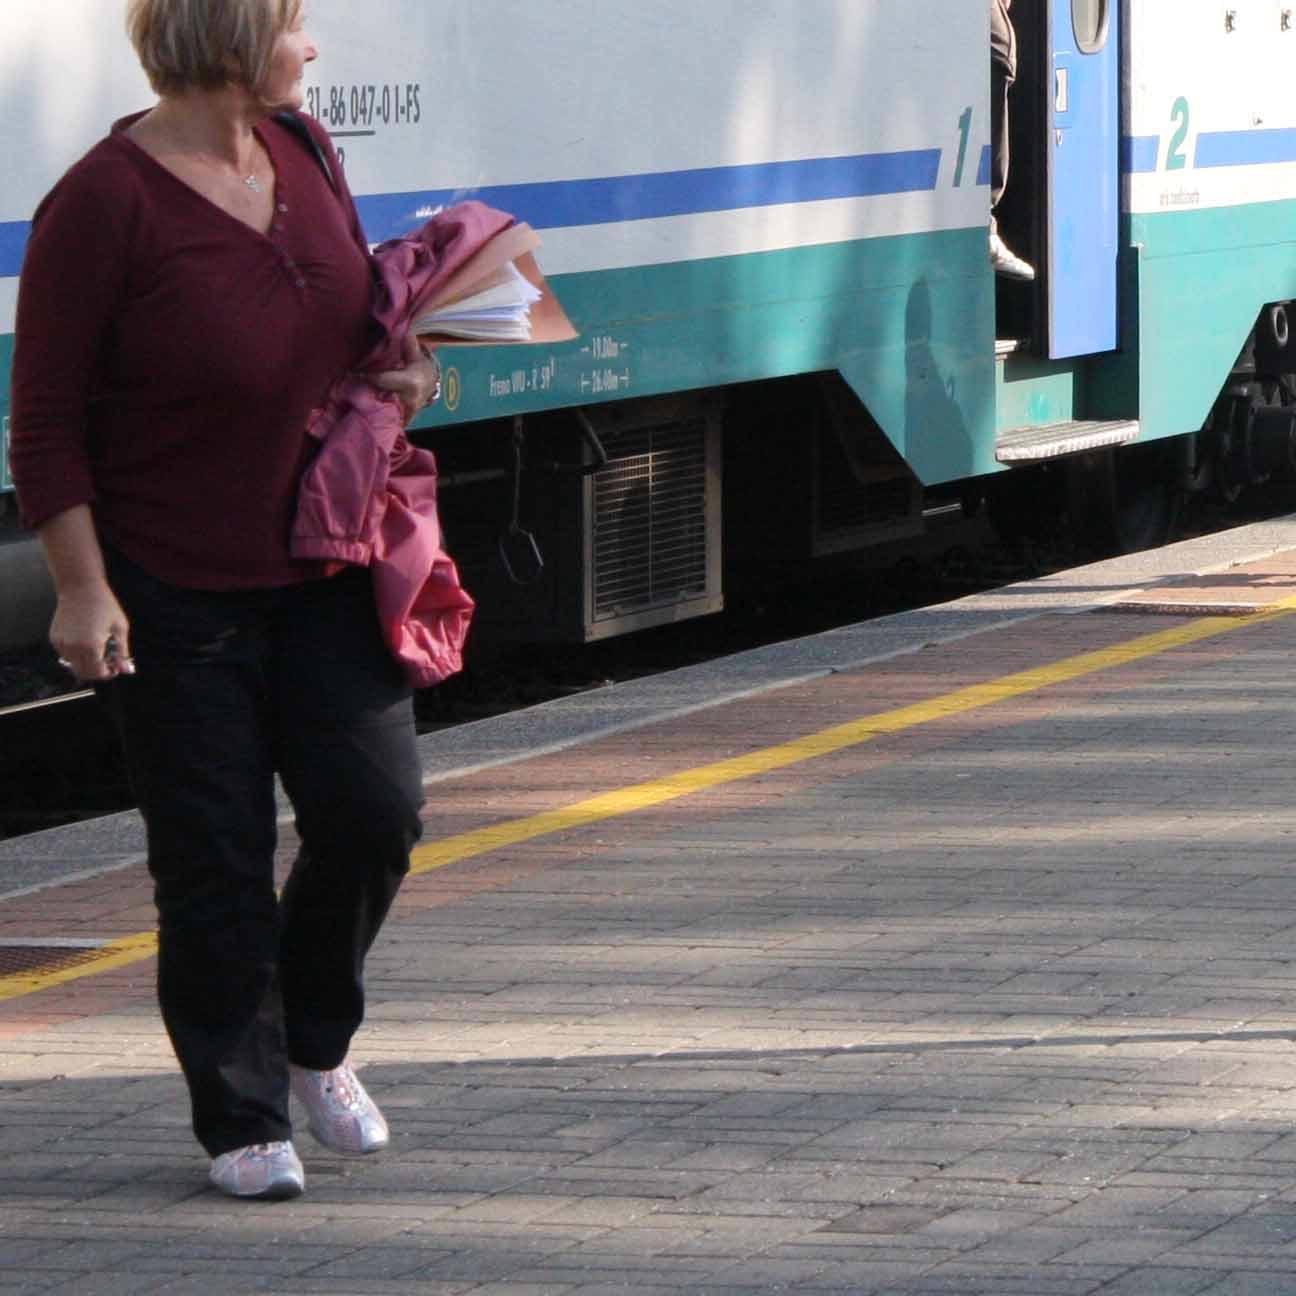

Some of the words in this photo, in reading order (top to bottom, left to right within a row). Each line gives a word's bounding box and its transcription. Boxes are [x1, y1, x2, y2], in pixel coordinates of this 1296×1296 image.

[350, 84, 390, 126] 047-0
[1165, 95, 1190, 171] 2
[952, 106, 973, 188] 1
